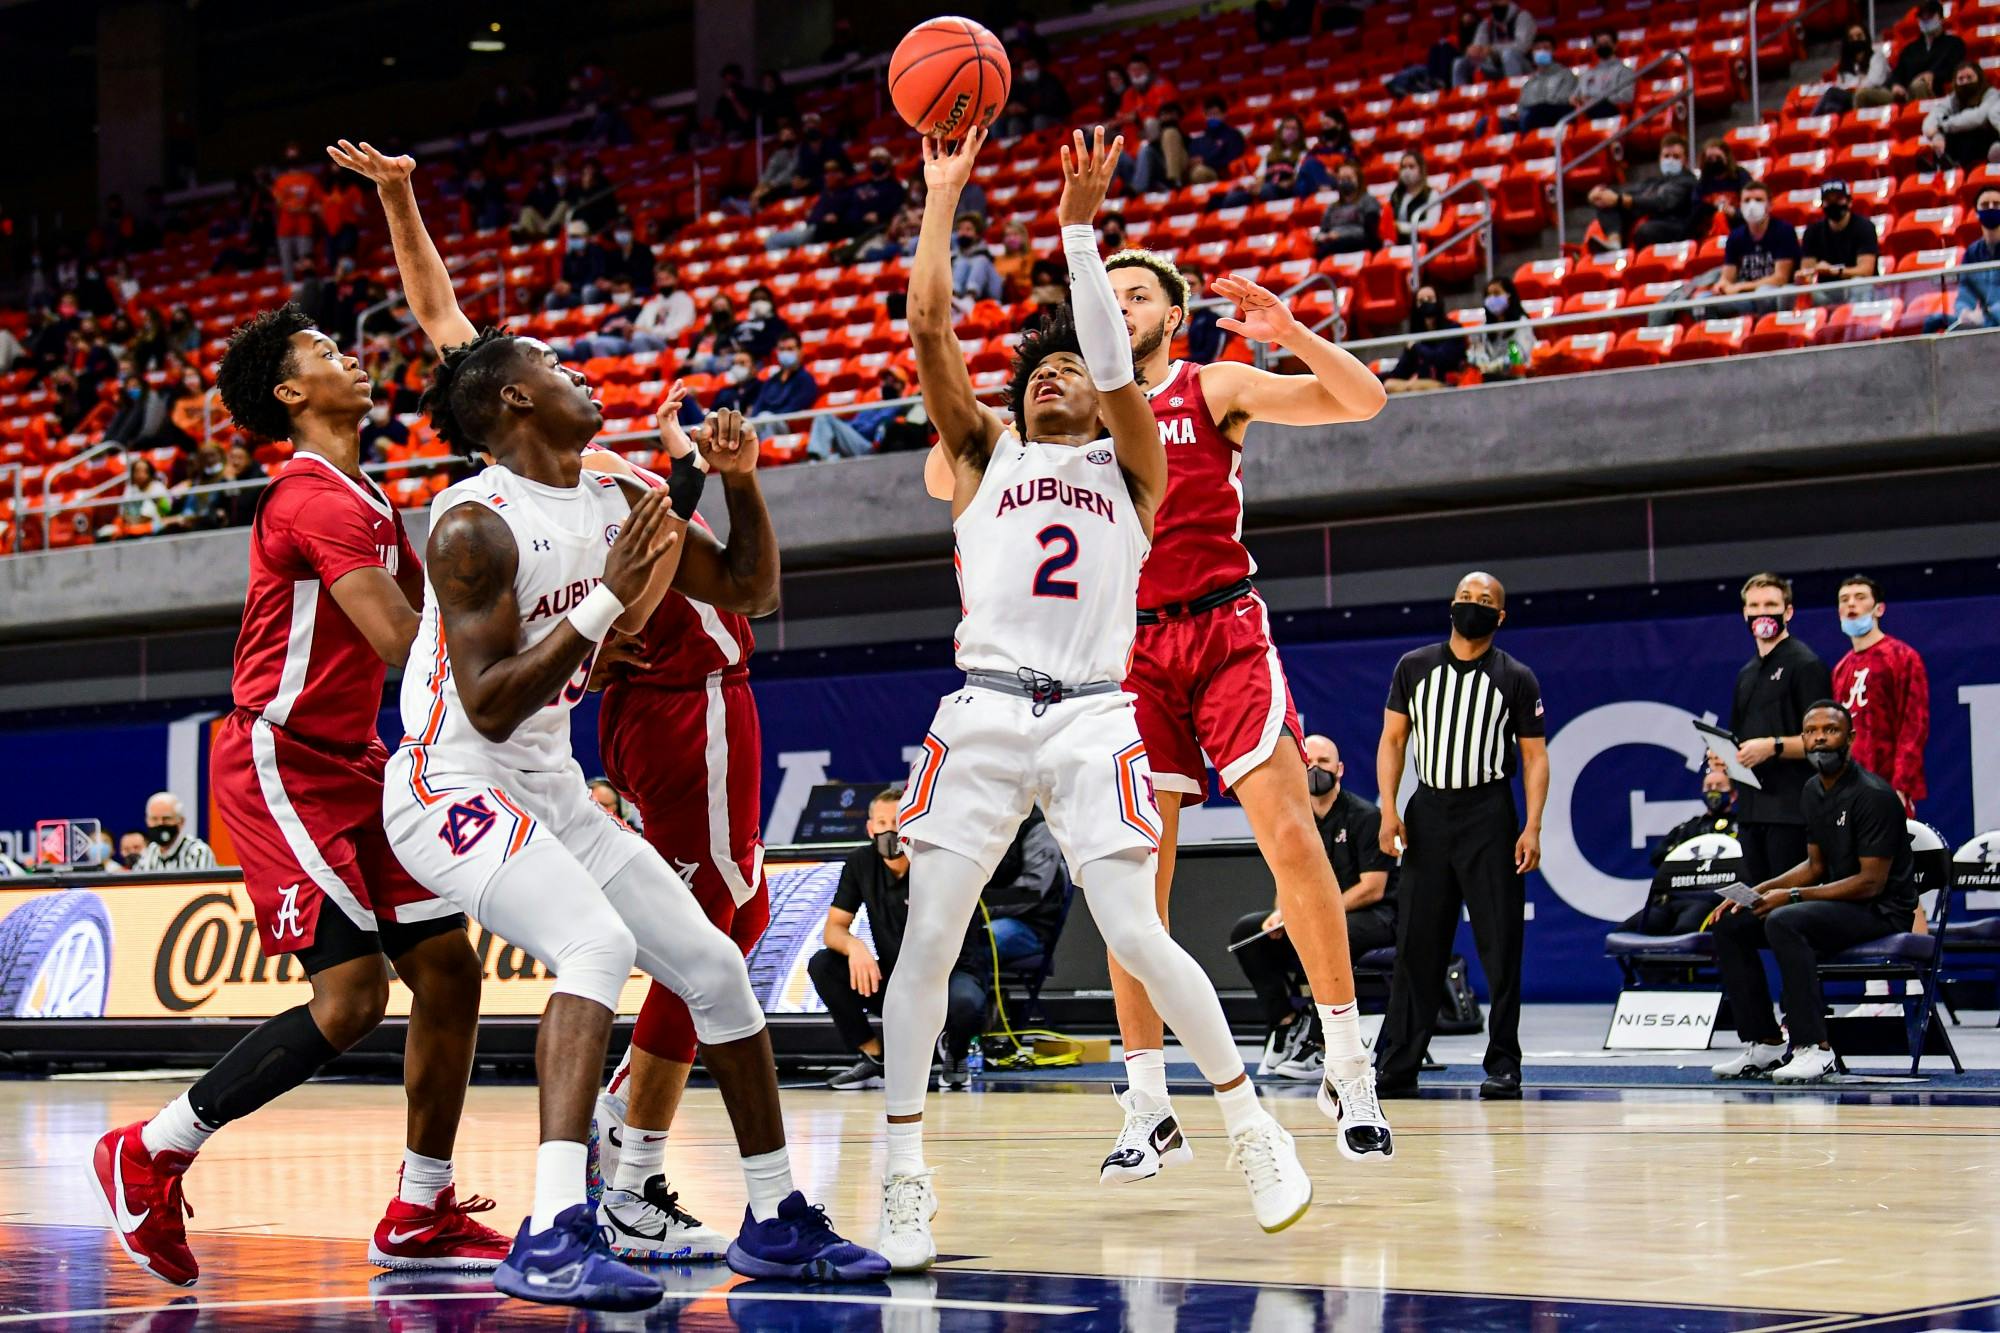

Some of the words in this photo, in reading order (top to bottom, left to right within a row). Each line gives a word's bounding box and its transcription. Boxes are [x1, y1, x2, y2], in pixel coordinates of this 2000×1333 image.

[995, 477, 1116, 524] AUBURN
[1032, 523, 1080, 600] 2
[271, 883, 304, 939] A
[1617, 1014, 1712, 1027] NISSAN
